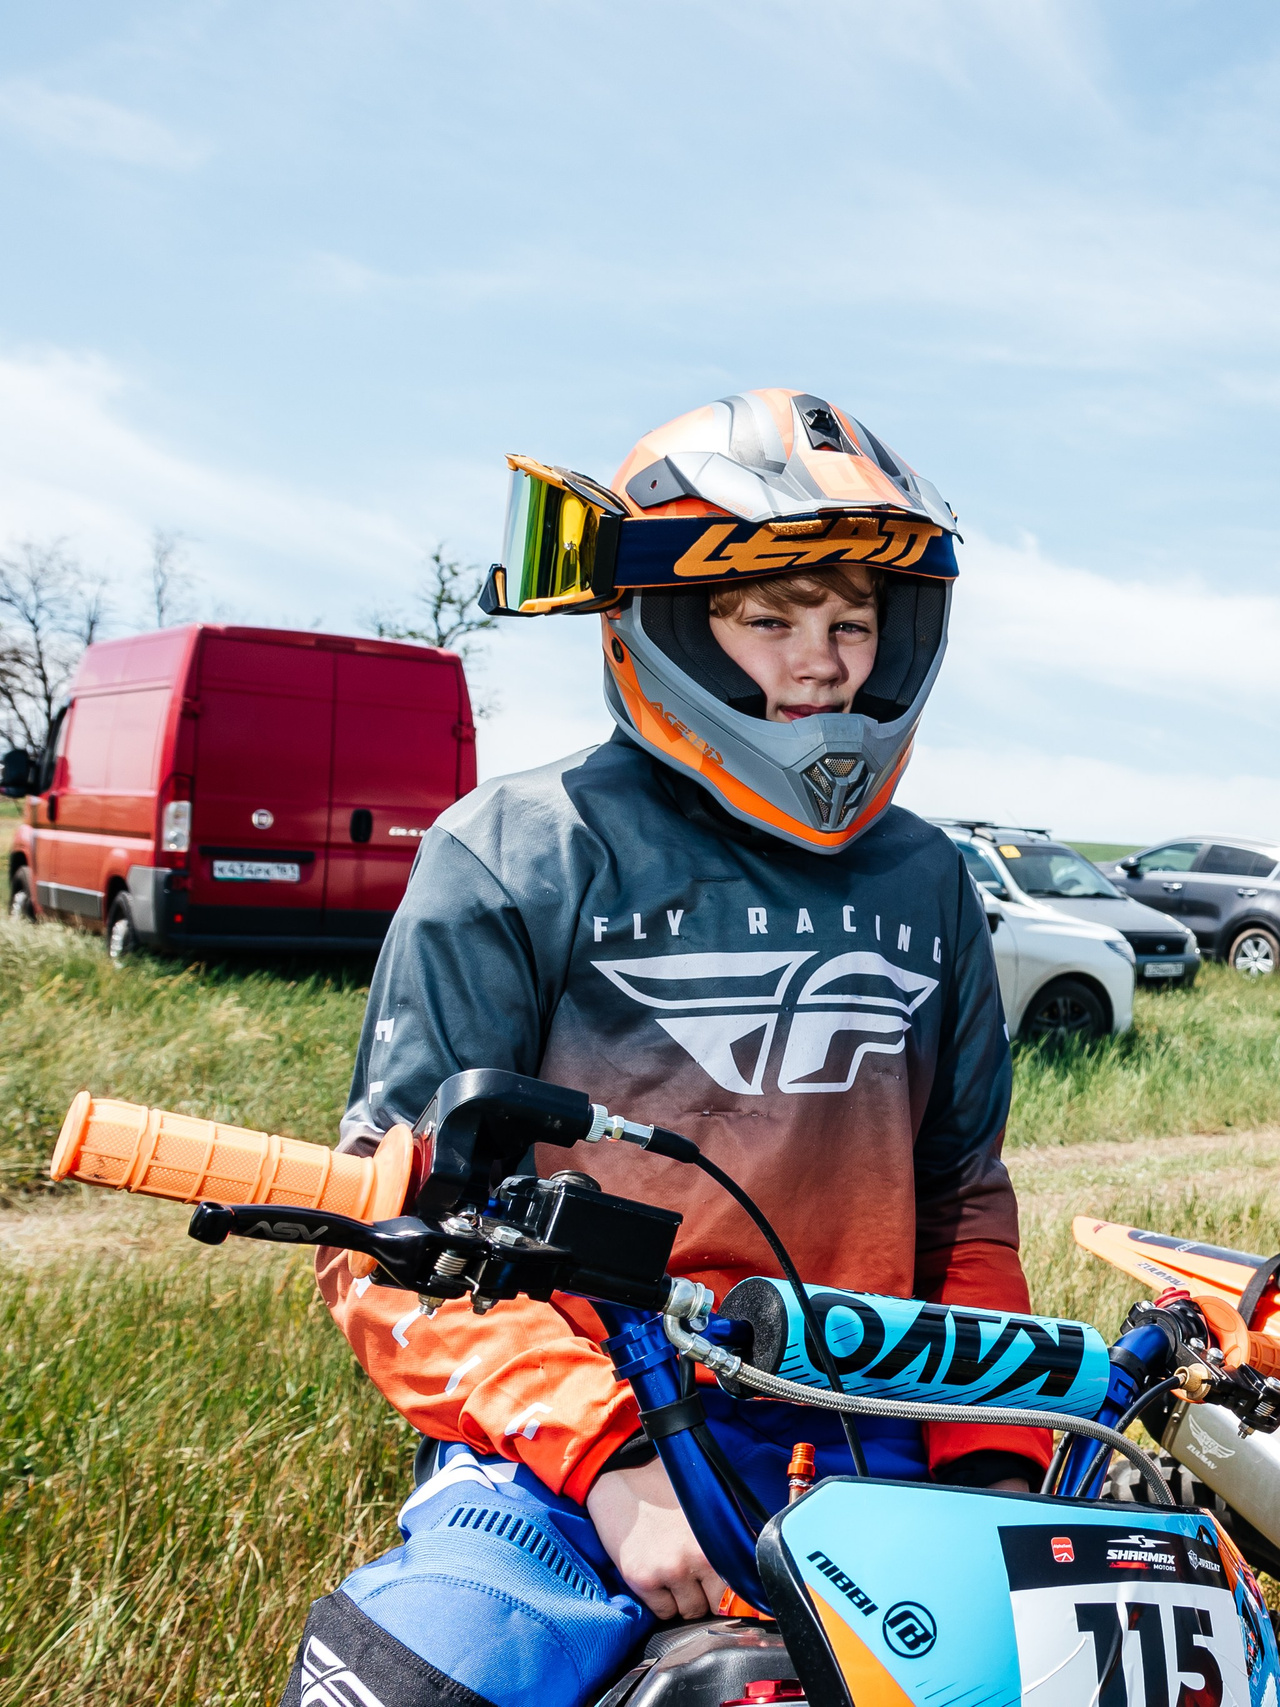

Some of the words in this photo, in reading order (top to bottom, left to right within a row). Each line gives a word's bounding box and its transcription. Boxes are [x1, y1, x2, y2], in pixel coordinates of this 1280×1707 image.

[673, 517, 942, 577] LEATT
[593, 909, 684, 942] FLY
[747, 904, 941, 964] RACING
[244, 1220, 328, 1241] ASV
[803, 1292, 1086, 1406] KAYO
[806, 1550, 879, 1617] NIBBI
[1106, 1549, 1176, 1565] SHARMAX
[1153, 1564, 1176, 1572] MOTORS
[1073, 1601, 1224, 1707] 115
